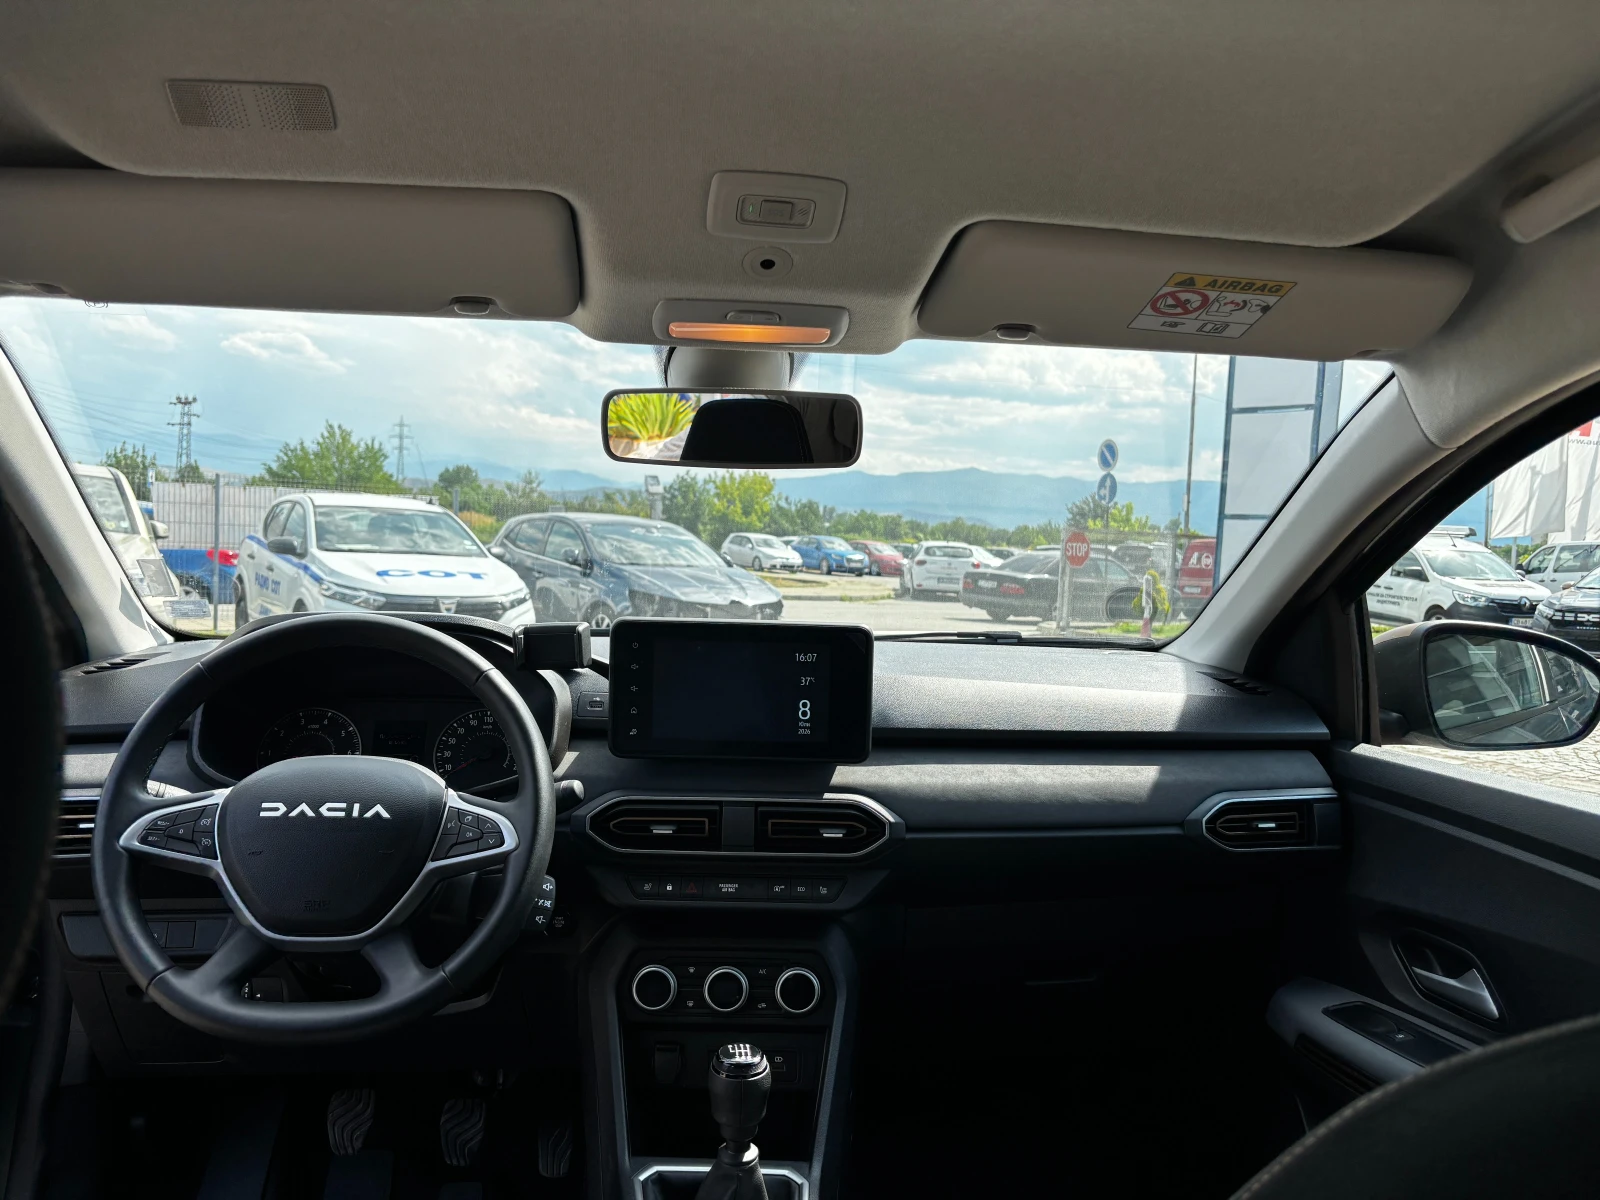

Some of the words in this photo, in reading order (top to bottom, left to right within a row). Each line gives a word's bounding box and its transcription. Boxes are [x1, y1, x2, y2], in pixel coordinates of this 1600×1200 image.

[1203, 278, 1284, 294] AIRBAG
[1065, 542, 1088, 557] STOP
[376, 569, 488, 580] СОТ
[255, 571, 269, 591] РАДИО
[271, 579, 281, 596] СОТ
[795, 653, 817, 662] 16:07
[798, 699, 811, 720] 8
[457, 727, 465, 735] 70
[448, 737, 456, 745] 50
[443, 750, 452, 758] 30
[259, 802, 392, 819] DACIA
